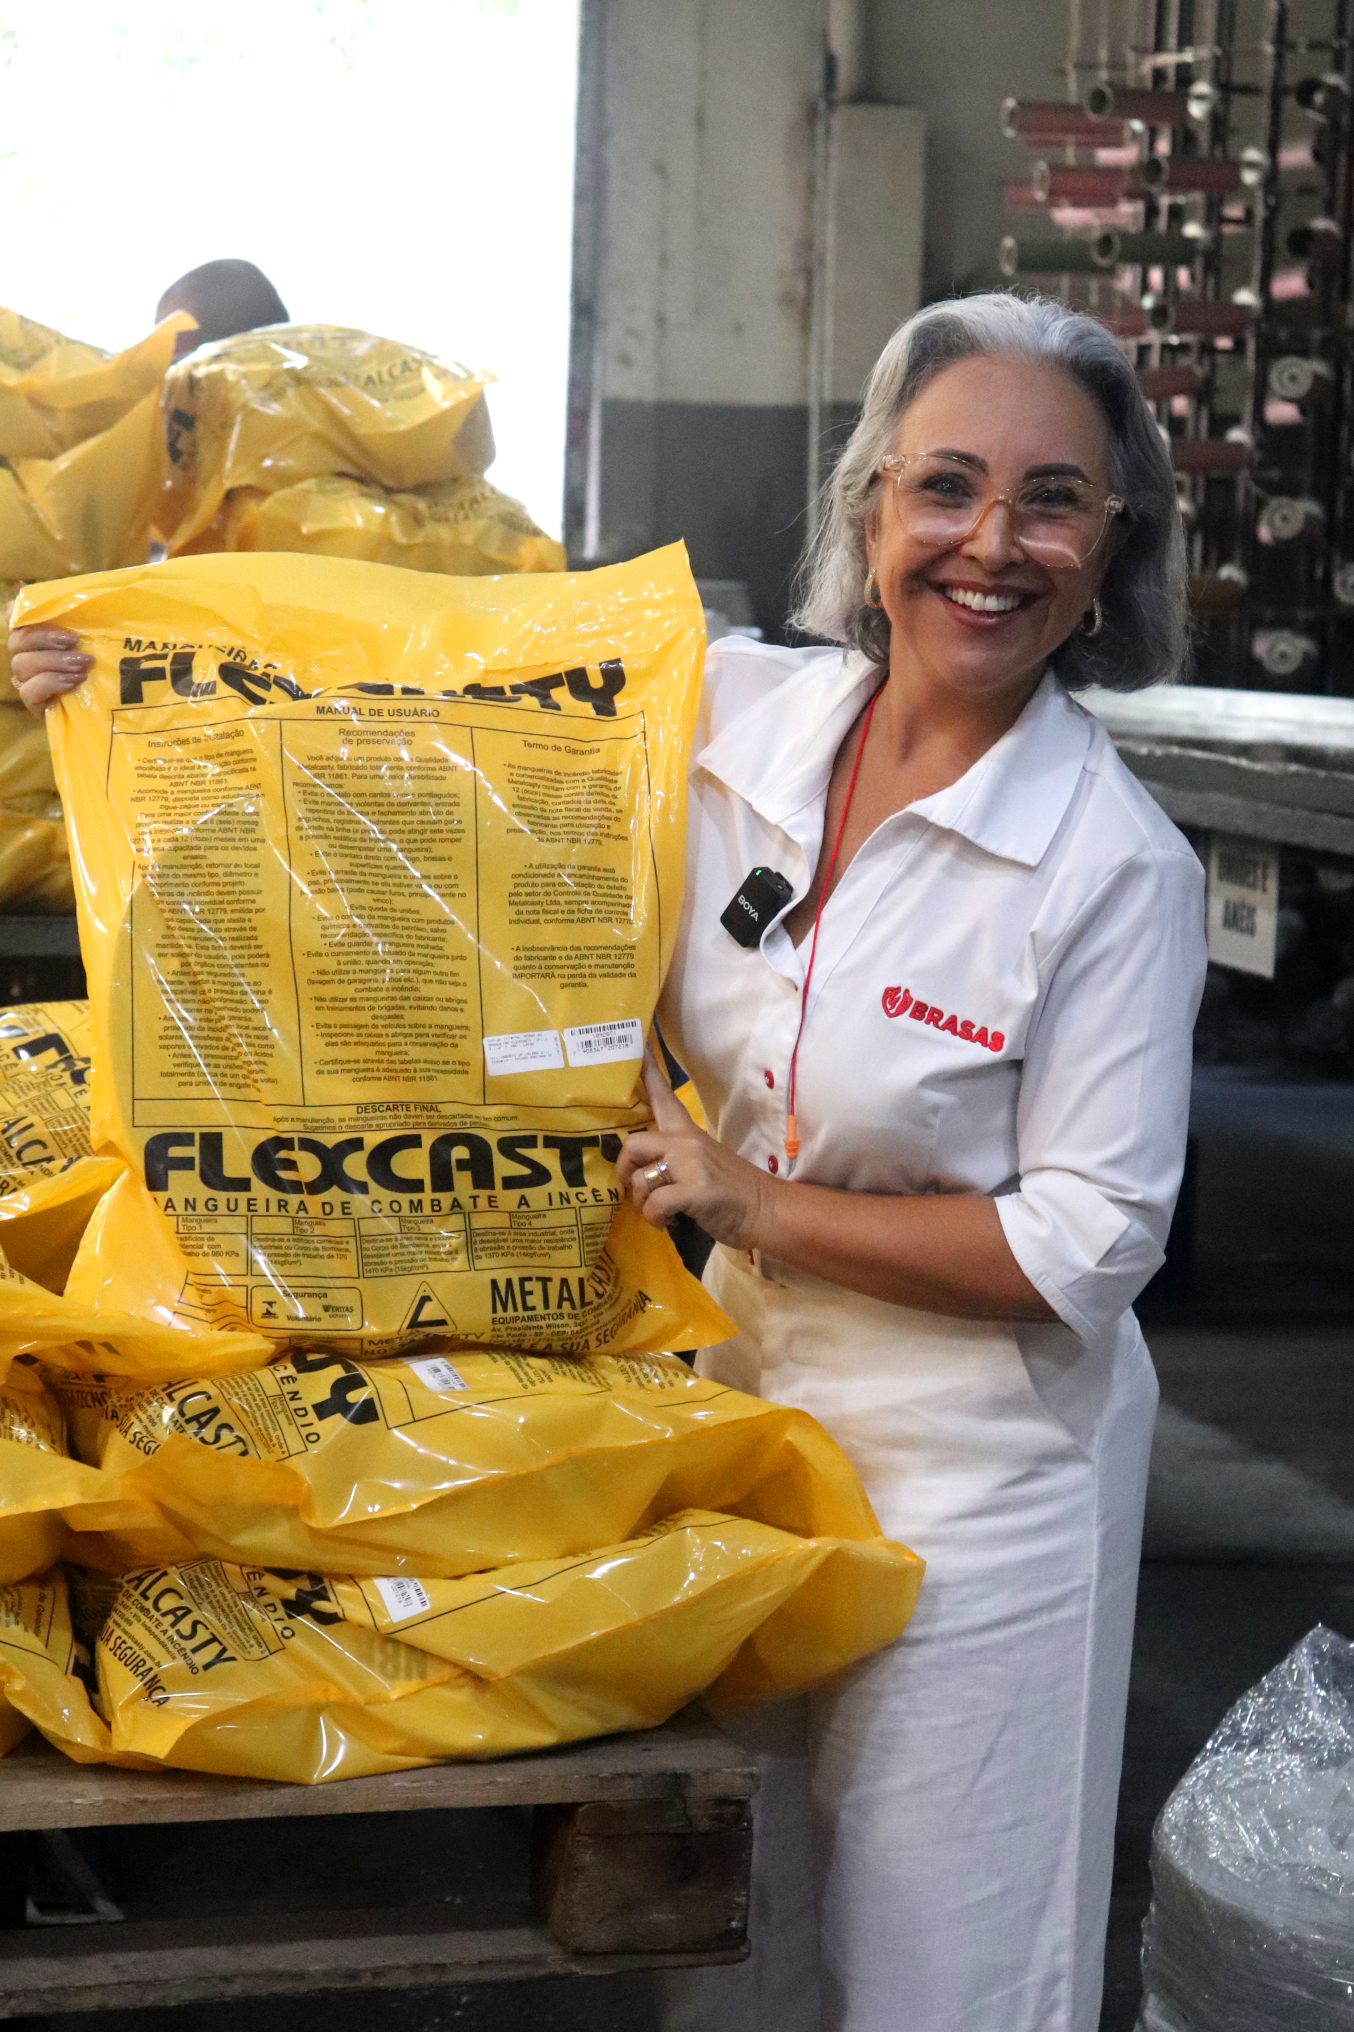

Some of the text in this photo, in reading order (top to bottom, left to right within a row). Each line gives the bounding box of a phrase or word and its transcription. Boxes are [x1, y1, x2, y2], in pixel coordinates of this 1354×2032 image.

[316, 705, 440, 718] MANUAL DE USUÁRIO
[339, 728, 416, 739] Recomendações
[357, 737, 413, 746] preservação
[522, 740, 600, 756] Termo de Garantia
[738, 894, 759, 922] BOYA
[583, 944, 636, 953] recomendações
[544, 963, 586, 972] conservação
[594, 963, 634, 971] manutenção
[909, 1000, 1005, 1052] BRASAS
[357, 1104, 441, 1115] DESCARTE FINAL
[154, 1187, 627, 1215] ANGUEIRA DE COMBATE A INCÊN
[283, 1290, 327, 1299] Segurança
[492, 1312, 565, 1325] EQUIPAMENTOS
[122, 1590, 200, 1675] DE COMBATE A INCÊNDIO
[141, 1619, 176, 1660] Independência
